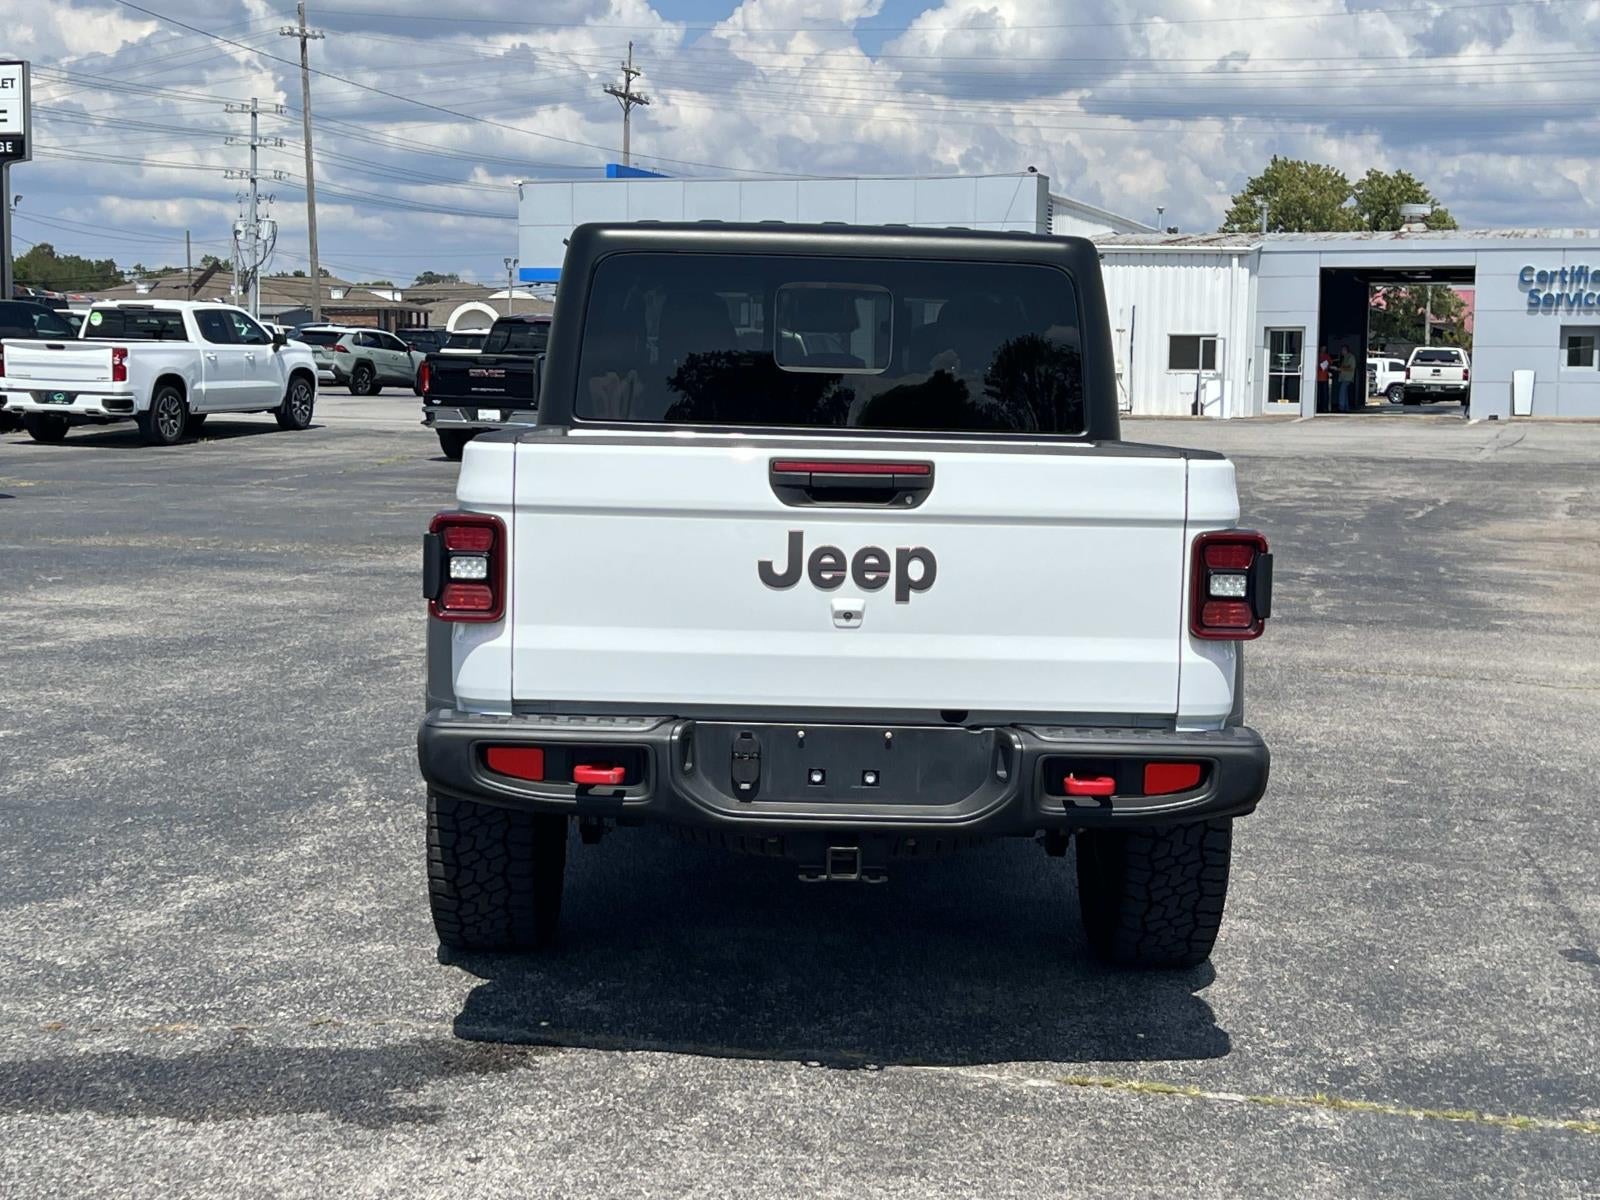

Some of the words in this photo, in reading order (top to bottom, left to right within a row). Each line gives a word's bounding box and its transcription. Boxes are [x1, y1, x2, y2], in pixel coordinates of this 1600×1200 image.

[0, 77, 16, 89] ET
[1528, 288, 1600, 308] Servic
[757, 530, 937, 604] Jeep
